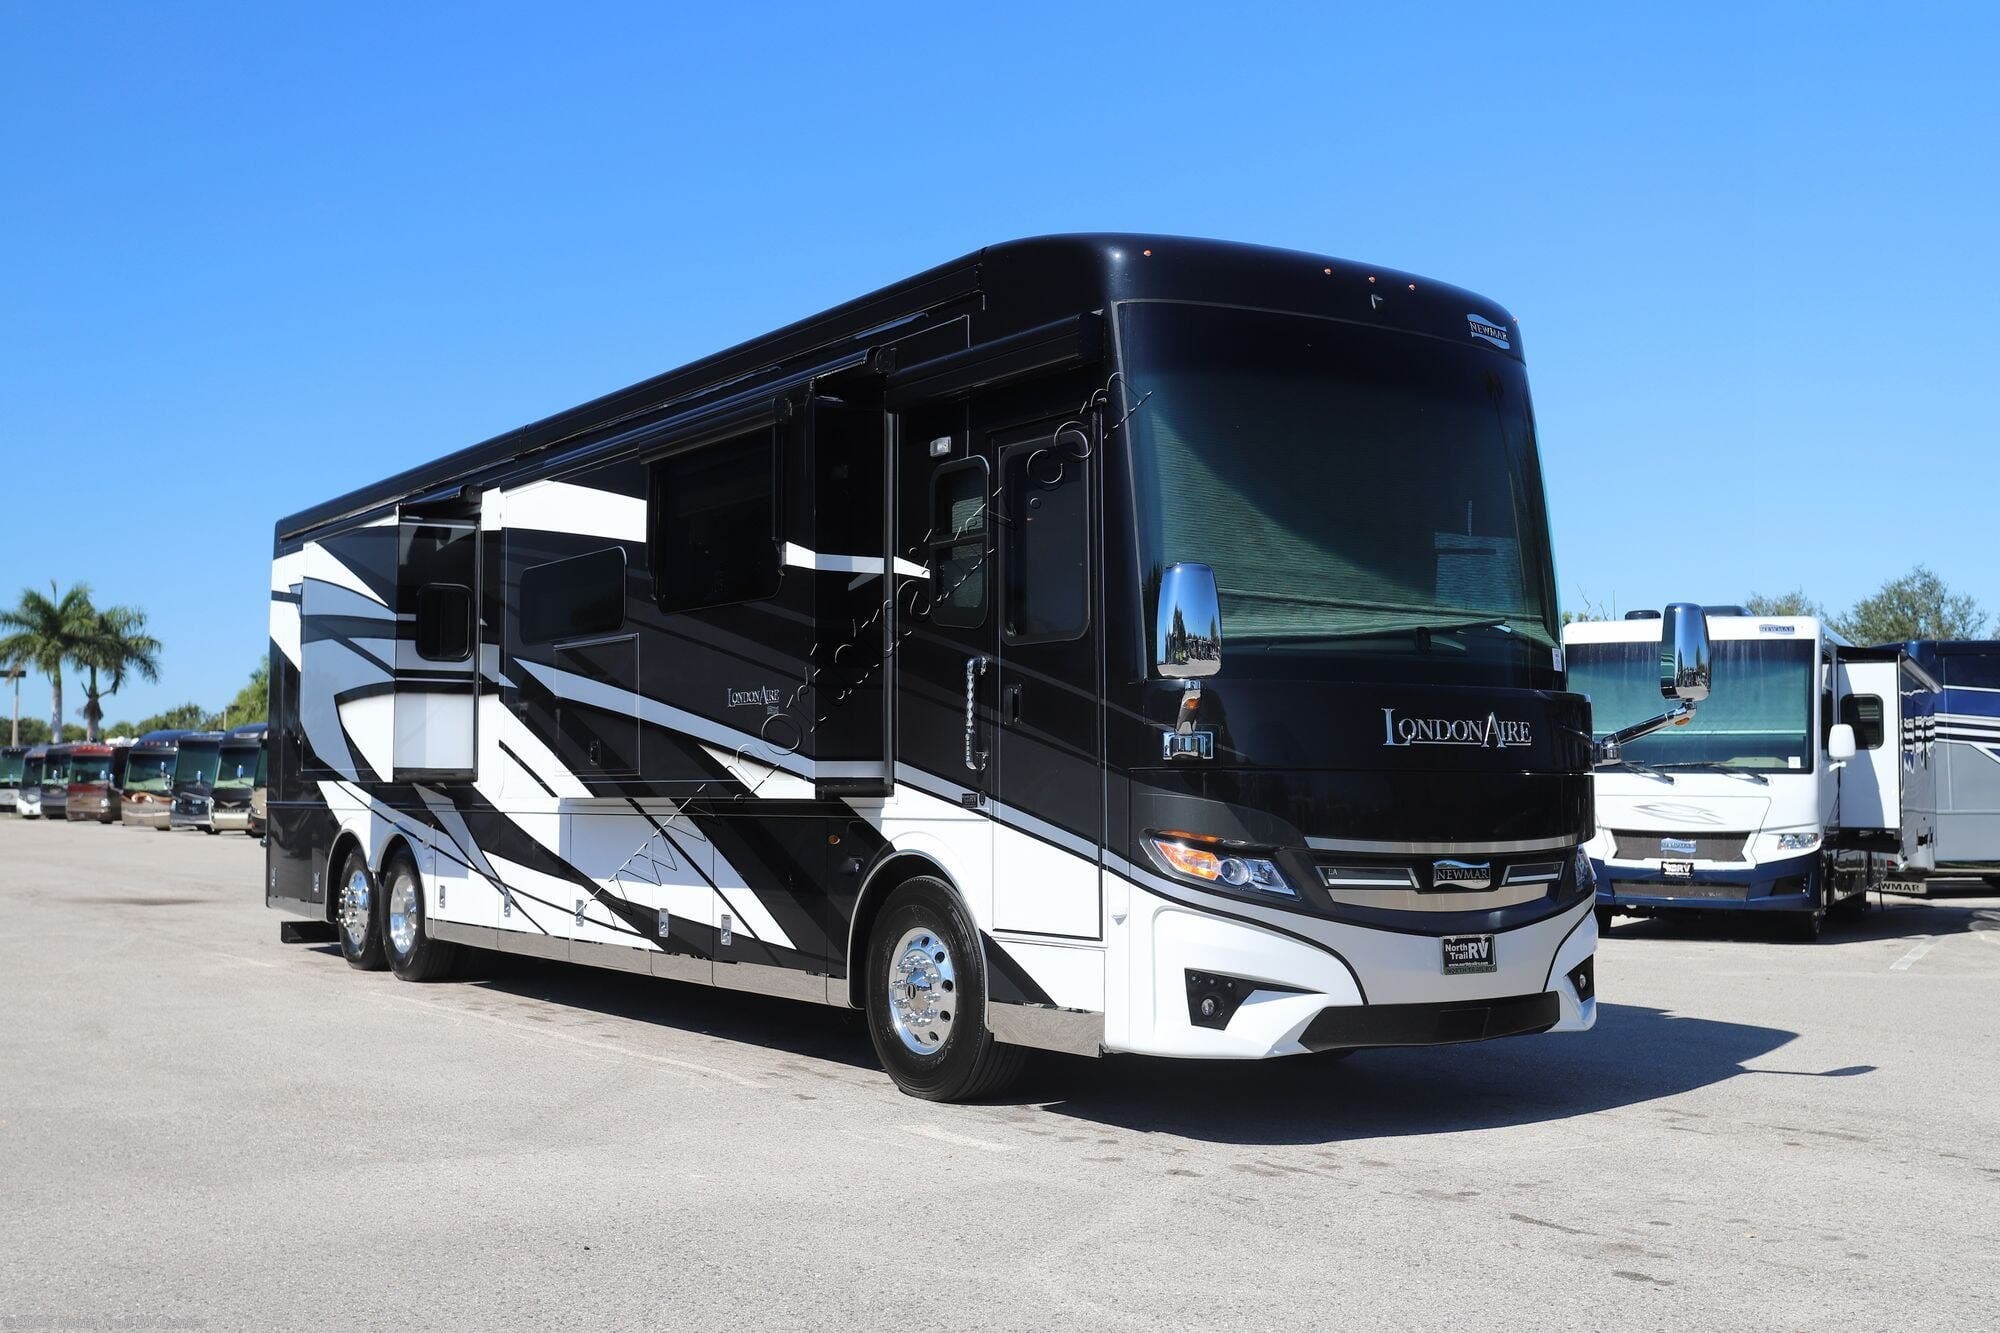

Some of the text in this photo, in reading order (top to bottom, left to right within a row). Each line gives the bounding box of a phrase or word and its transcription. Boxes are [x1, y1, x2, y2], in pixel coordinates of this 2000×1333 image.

[1469, 321, 1508, 341] NEWMAR
[1437, 868, 1489, 880] NEWMAR
[1445, 943, 1468, 952] North
[1468, 942, 1489, 959] RV
[1450, 951, 1469, 960] Trail
